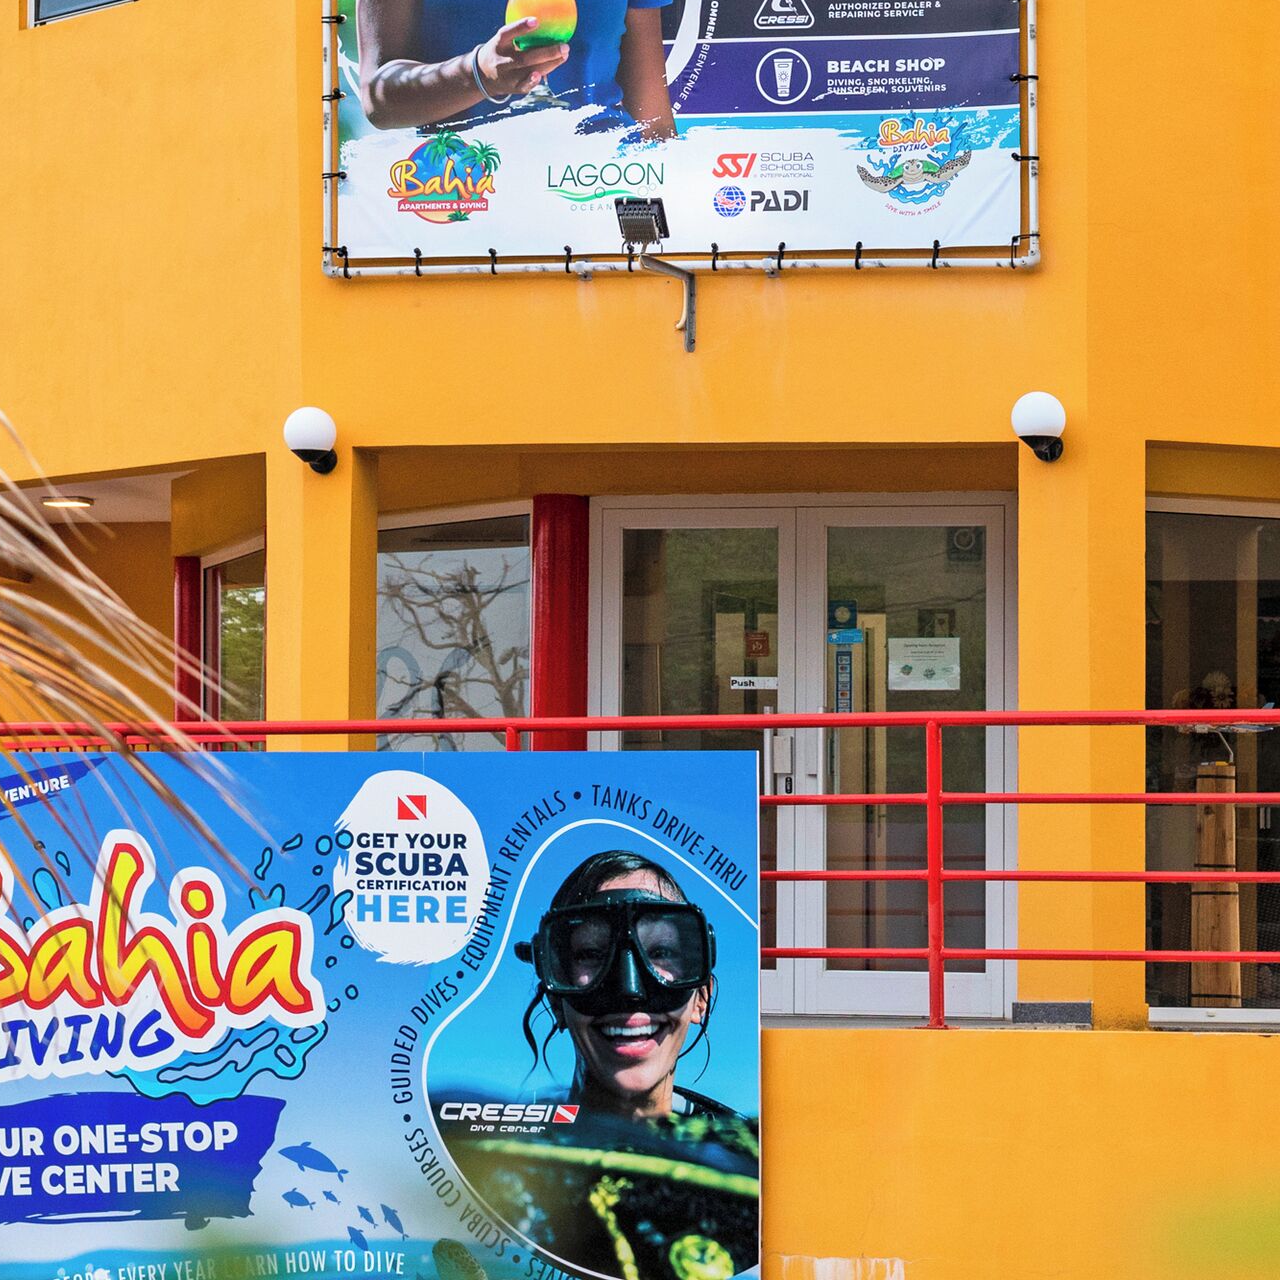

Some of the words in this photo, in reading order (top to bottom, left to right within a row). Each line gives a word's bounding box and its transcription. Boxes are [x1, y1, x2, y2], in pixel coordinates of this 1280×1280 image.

[828, 2, 891, 11] AUTHORIZED
[828, 11, 880, 19] REPAIRING
[883, 9, 924, 17] SERVICE
[758, 16, 809, 24] CRESSI
[679, 43, 710, 101] BIENVENUE
[827, 59, 889, 73] BEACH
[895, 57, 945, 72] SHOP
[827, 79, 865, 87] DIVING,
[867, 77, 933, 86] SNORKELING,
[891, 84, 947, 93] SOUVENIRS
[879, 119, 950, 146] Bahia
[761, 152, 814, 161] SCUBA
[893, 142, 928, 153] DIVING
[548, 162, 664, 187] LAGOON
[712, 153, 758, 178] SSI
[761, 163, 815, 171] SCHOOLS
[387, 159, 496, 199] Bahia
[460, 201, 487, 209] DIVING
[570, 204, 613, 212] OCEAN
[750, 190, 809, 212] PADI
[592, 784, 652, 821] TANKS
[498, 790, 568, 862] RENTALS
[357, 834, 398, 849] GET
[408, 834, 467, 850] YOUR
[652, 806, 749, 892] DRIVE-THRU
[355, 851, 469, 877] SCUBA
[357, 879, 467, 891] CERTIFICATION
[357, 895, 468, 924] HERE
[460, 862, 512, 972] EQUIPMENT
[411, 975, 459, 1025] DIVES
[390, 1024, 418, 1104] GUIDED
[439, 1102, 553, 1123] CRESSI
[53, 1121, 238, 1155] ONE-STOP
[40, 1163, 180, 1196] CENTER
[404, 1127, 462, 1208] COURSES
[460, 1203, 511, 1257] SCUBA
[118, 1263, 167, 1280] EVERY
[173, 1259, 215, 1280] YEAR
[222, 1253, 278, 1277] ARN
[285, 1250, 326, 1274] HOW
[334, 1250, 356, 1273] TO
[364, 1251, 405, 1275] DIVE
